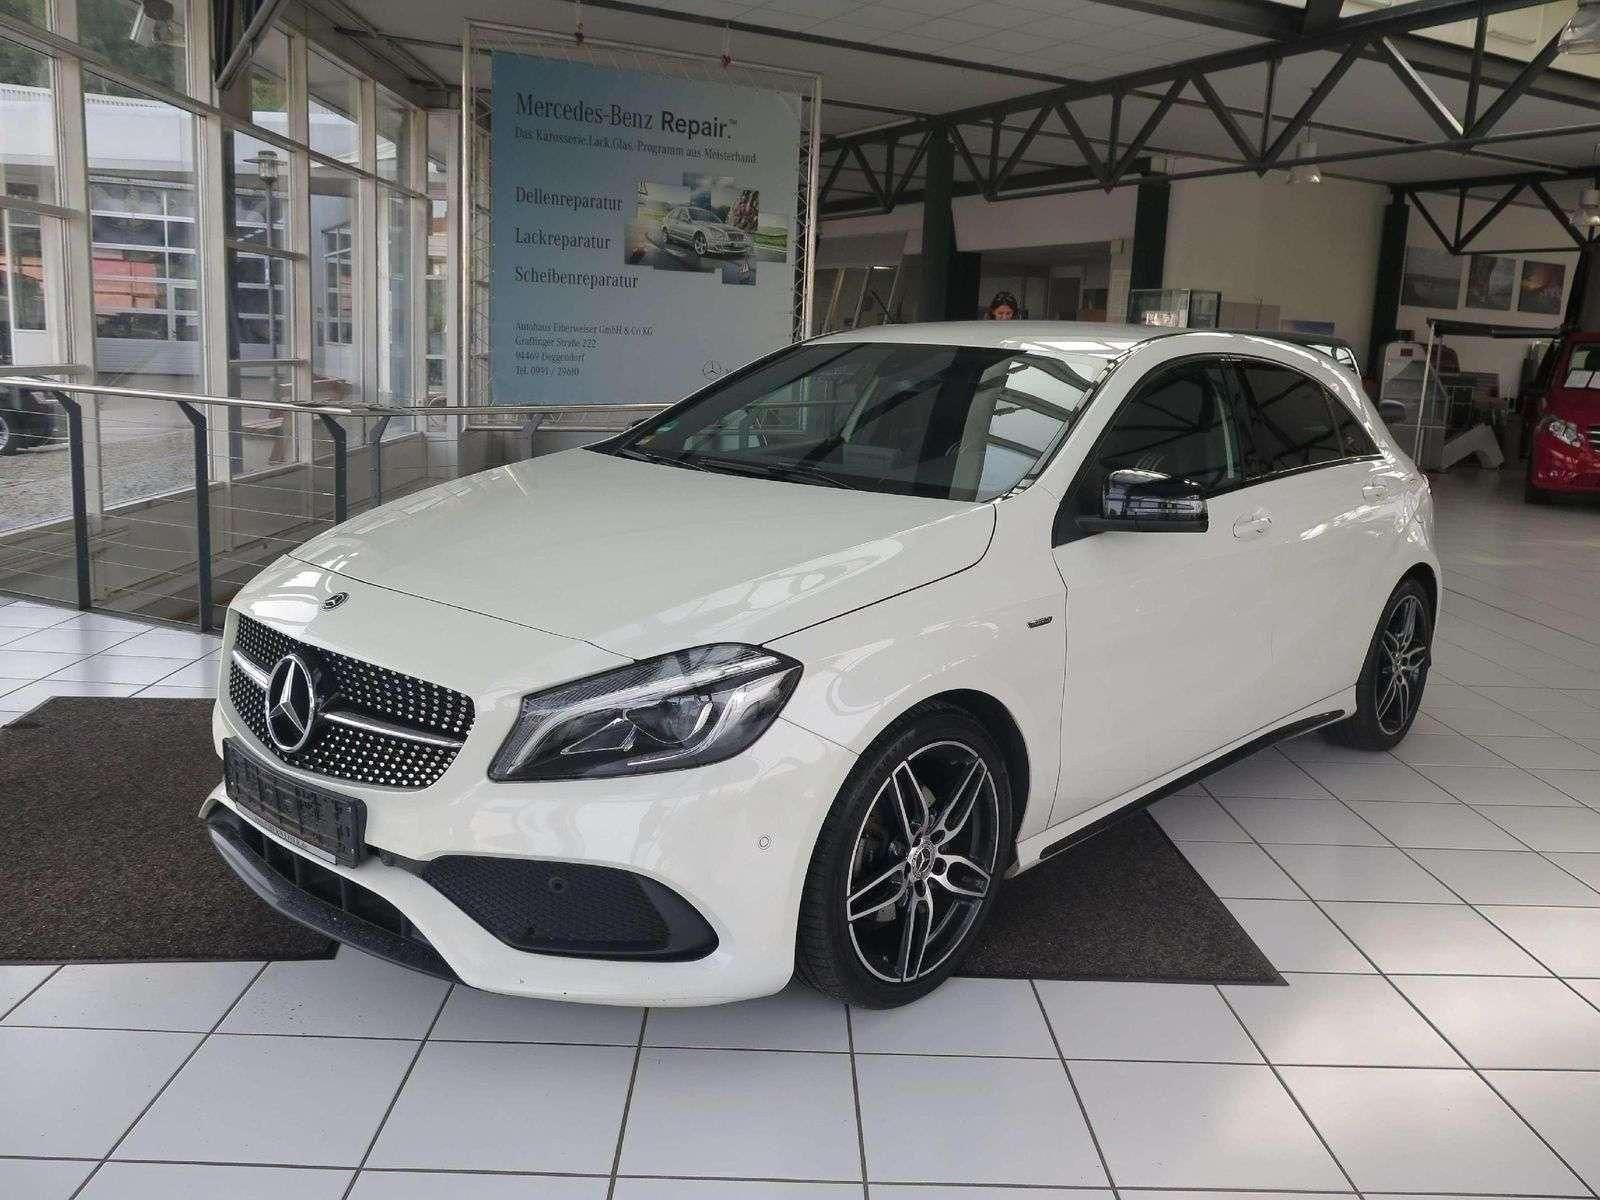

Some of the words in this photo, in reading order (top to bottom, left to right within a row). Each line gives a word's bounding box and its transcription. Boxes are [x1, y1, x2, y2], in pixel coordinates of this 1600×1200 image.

[515, 92, 653, 130] Mercedes-Benz
[514, 126, 533, 139] Das
[515, 186, 623, 211] Dellenreparatur
[515, 227, 611, 250] Lackreparatur
[515, 266, 639, 289] Scheibenreparatur
